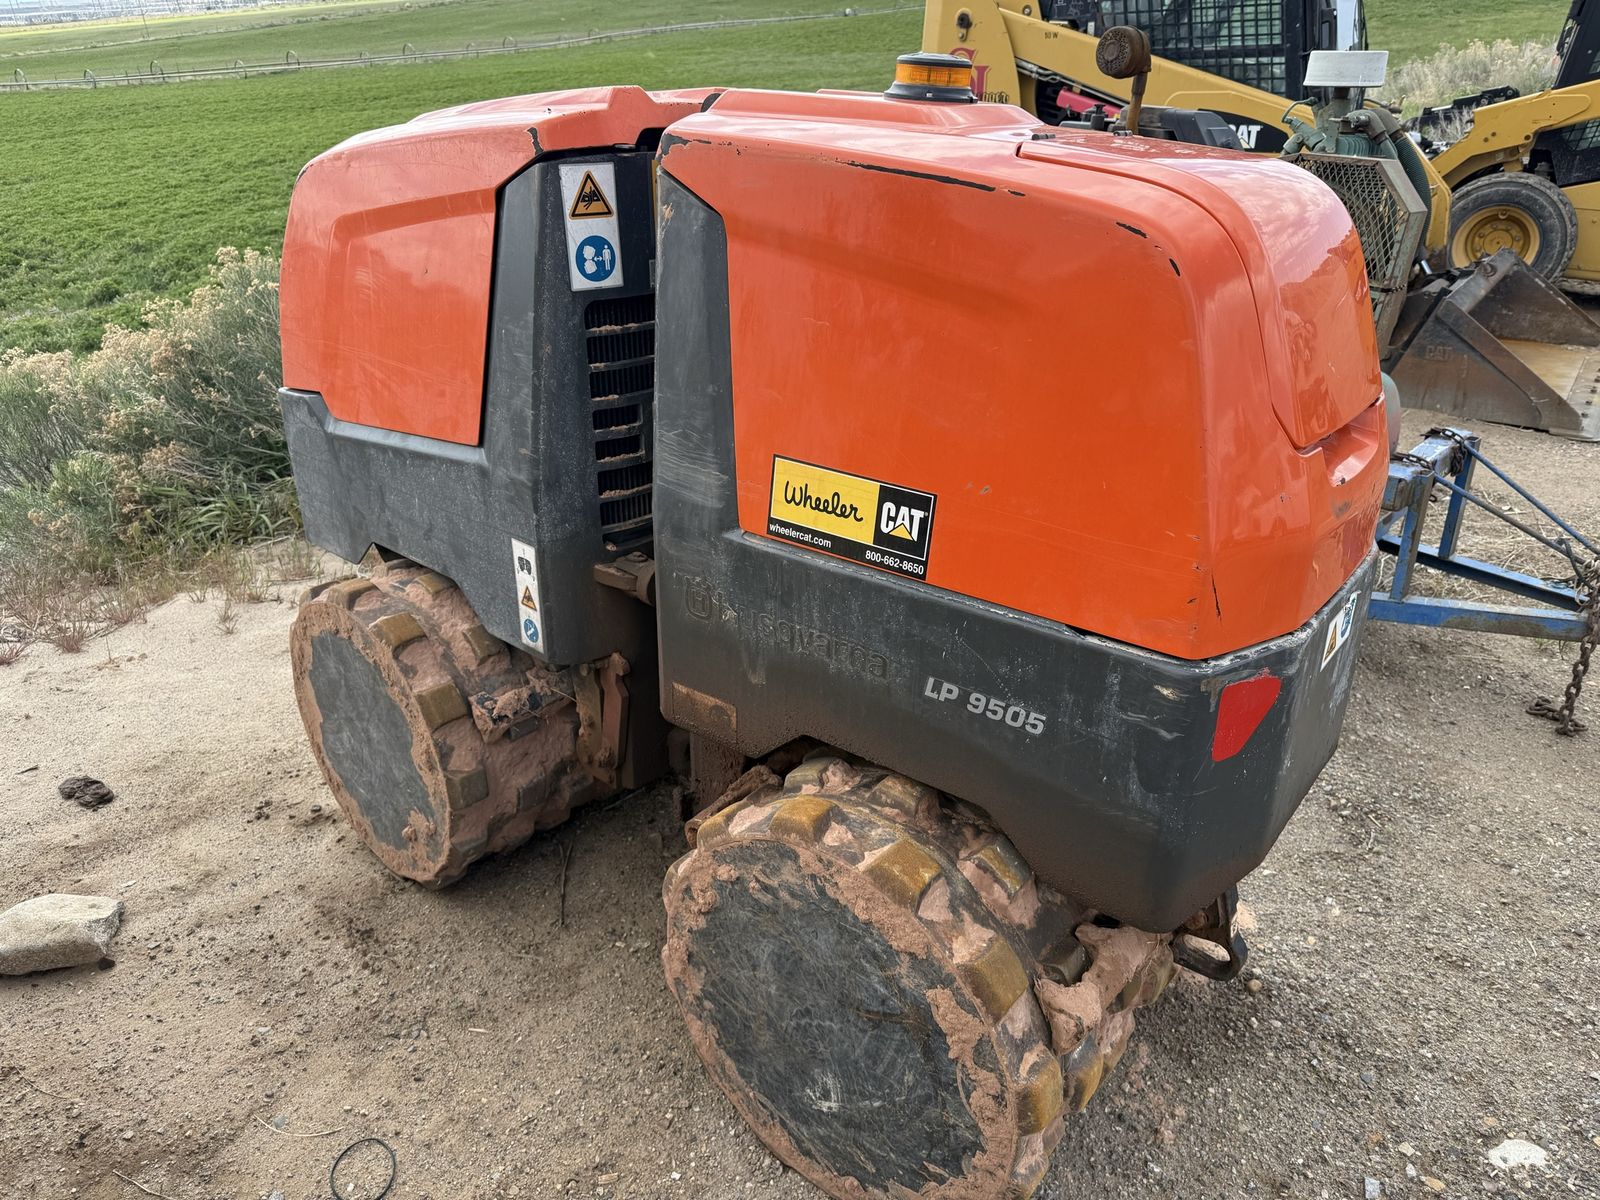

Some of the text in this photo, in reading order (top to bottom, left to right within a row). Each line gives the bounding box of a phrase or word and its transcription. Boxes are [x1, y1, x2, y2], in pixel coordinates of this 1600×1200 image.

[784, 480, 925, 542] Wheeler CAT
[769, 523, 832, 548] wheelercat.com
[865, 550, 924, 575] 800-662-8650
[924, 677, 1047, 735] LP 9505
